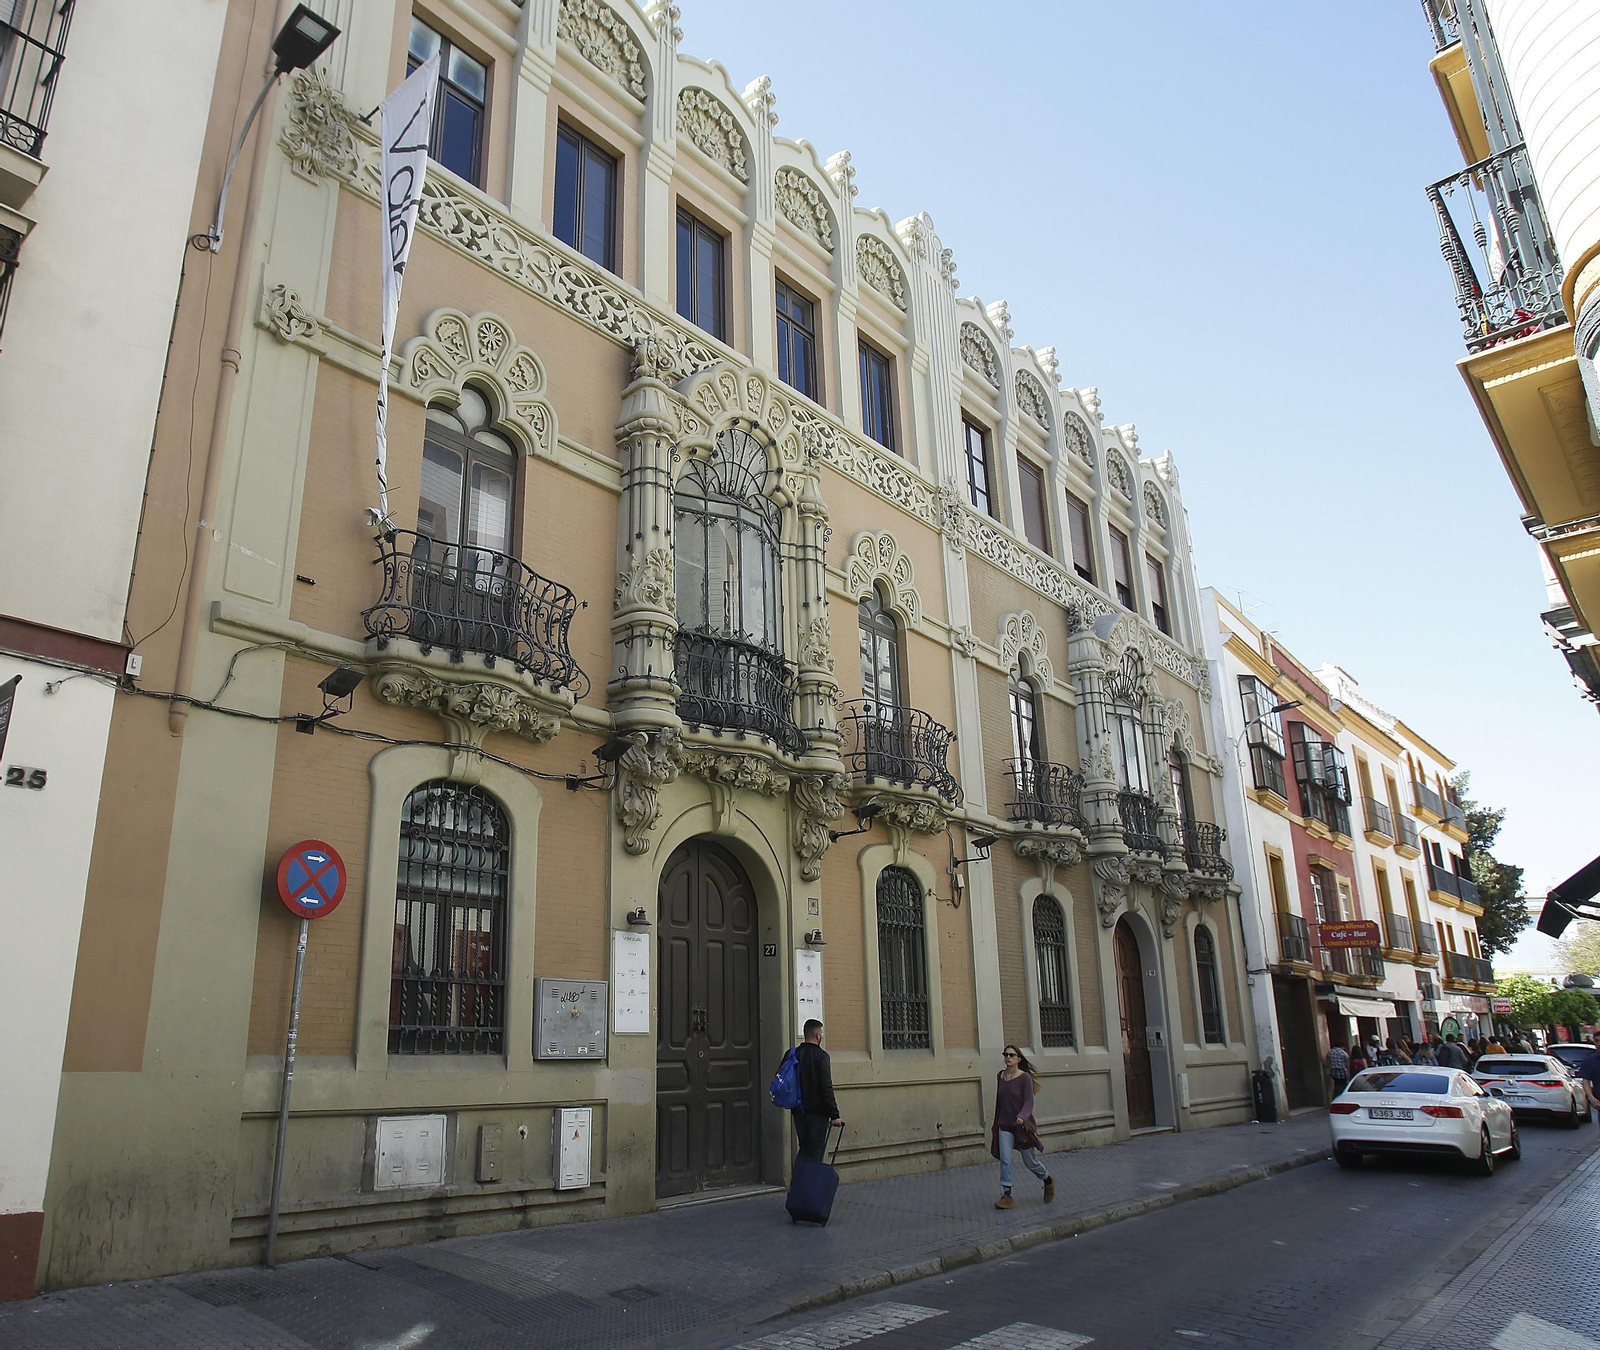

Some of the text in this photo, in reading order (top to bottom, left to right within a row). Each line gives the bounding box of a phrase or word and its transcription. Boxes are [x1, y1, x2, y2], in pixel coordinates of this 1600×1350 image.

[5, 766, 47, 790] 25
[765, 945, 775, 955] 27
[1373, 1109, 1412, 1119] 5363 JSC
